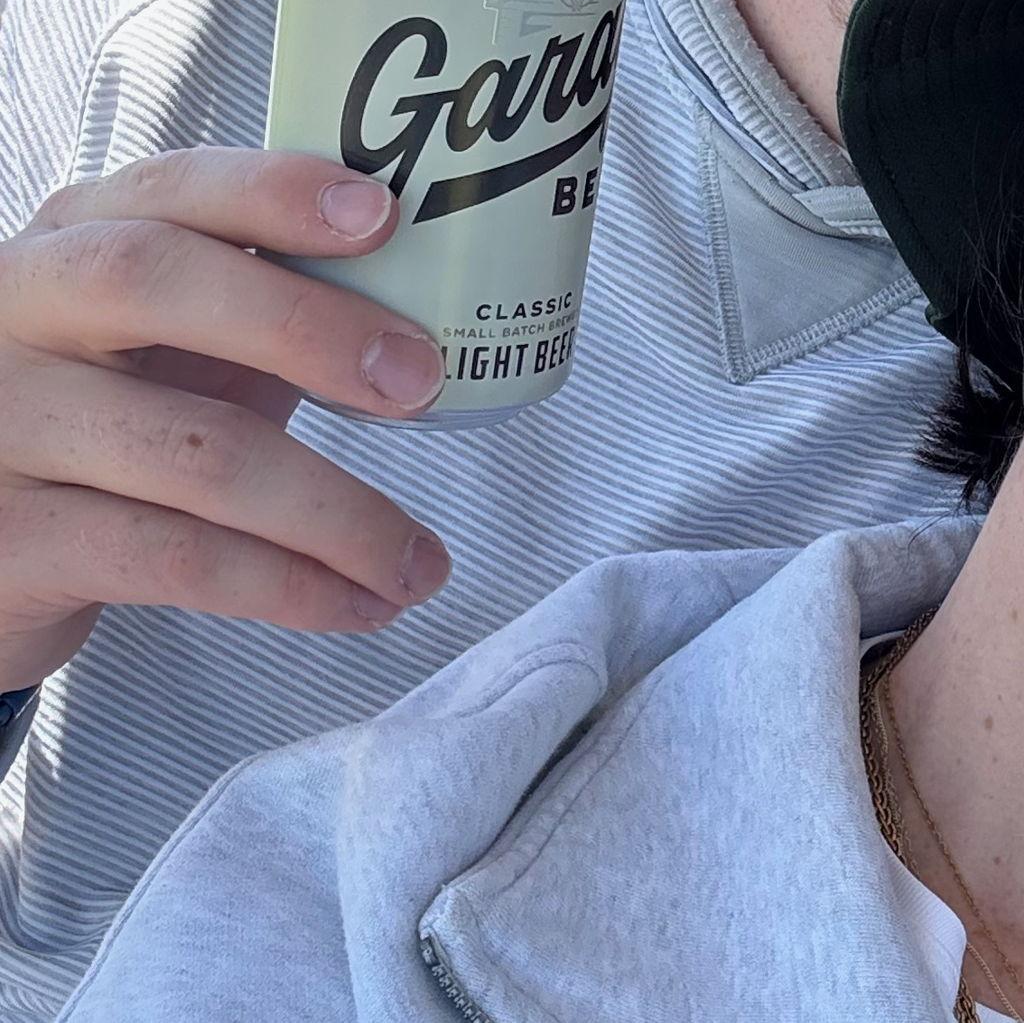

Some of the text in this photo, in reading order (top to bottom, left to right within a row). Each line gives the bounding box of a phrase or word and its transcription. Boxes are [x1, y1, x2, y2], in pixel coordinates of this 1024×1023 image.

[340, 0, 624, 200] Gara
[476, 291, 572, 321] CLASSIC
[443, 326, 496, 339] SMALL
[502, 322, 545, 339] BATCH
[442, 344, 528, 380] LIGHT
